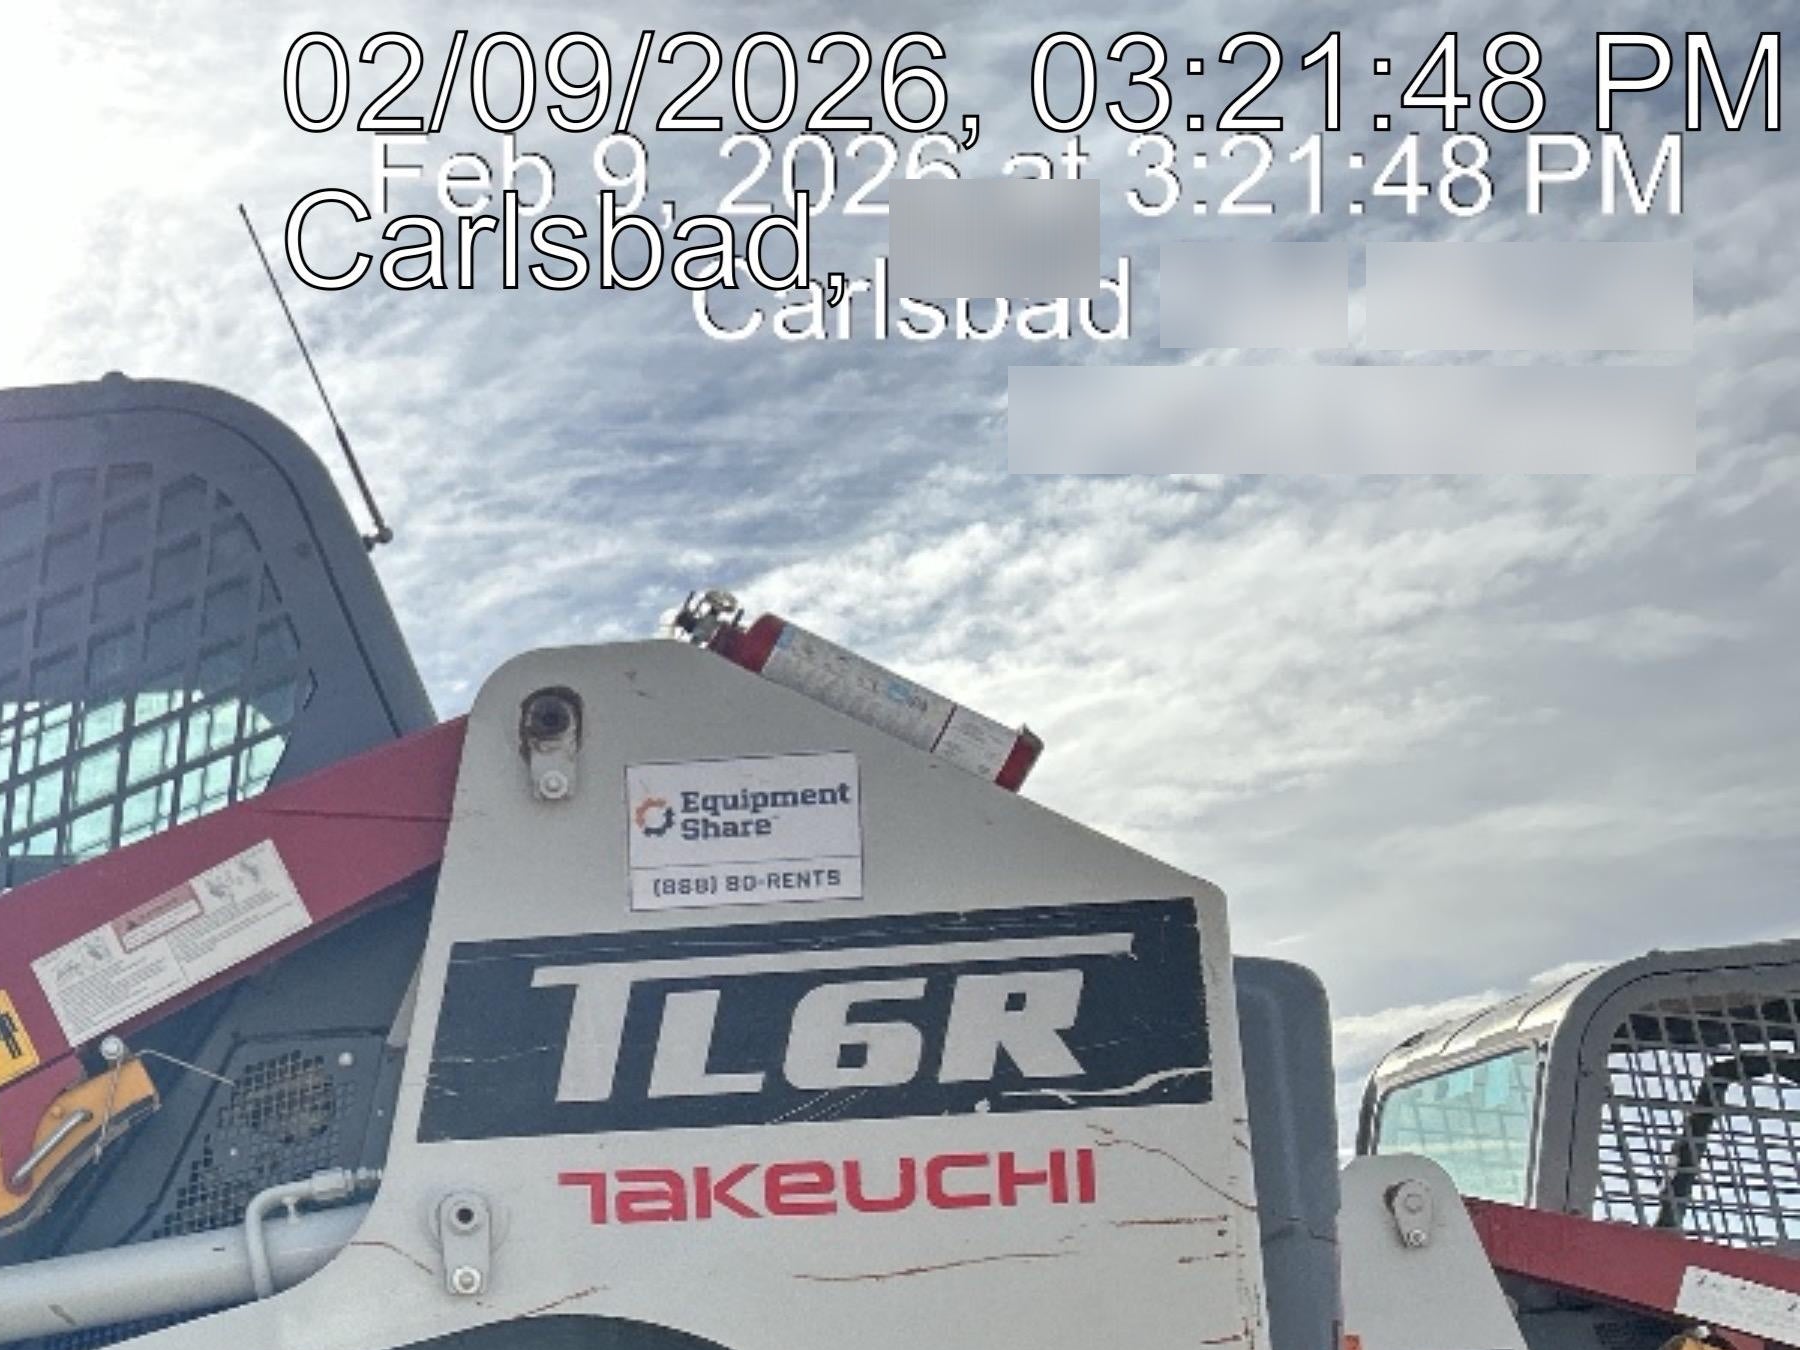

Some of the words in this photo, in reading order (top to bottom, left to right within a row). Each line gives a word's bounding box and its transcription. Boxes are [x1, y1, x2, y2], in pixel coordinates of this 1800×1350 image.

[680, 782, 851, 816] Equipment
[680, 817, 773, 841] Share
[531, 932, 1134, 1103] TL6R
